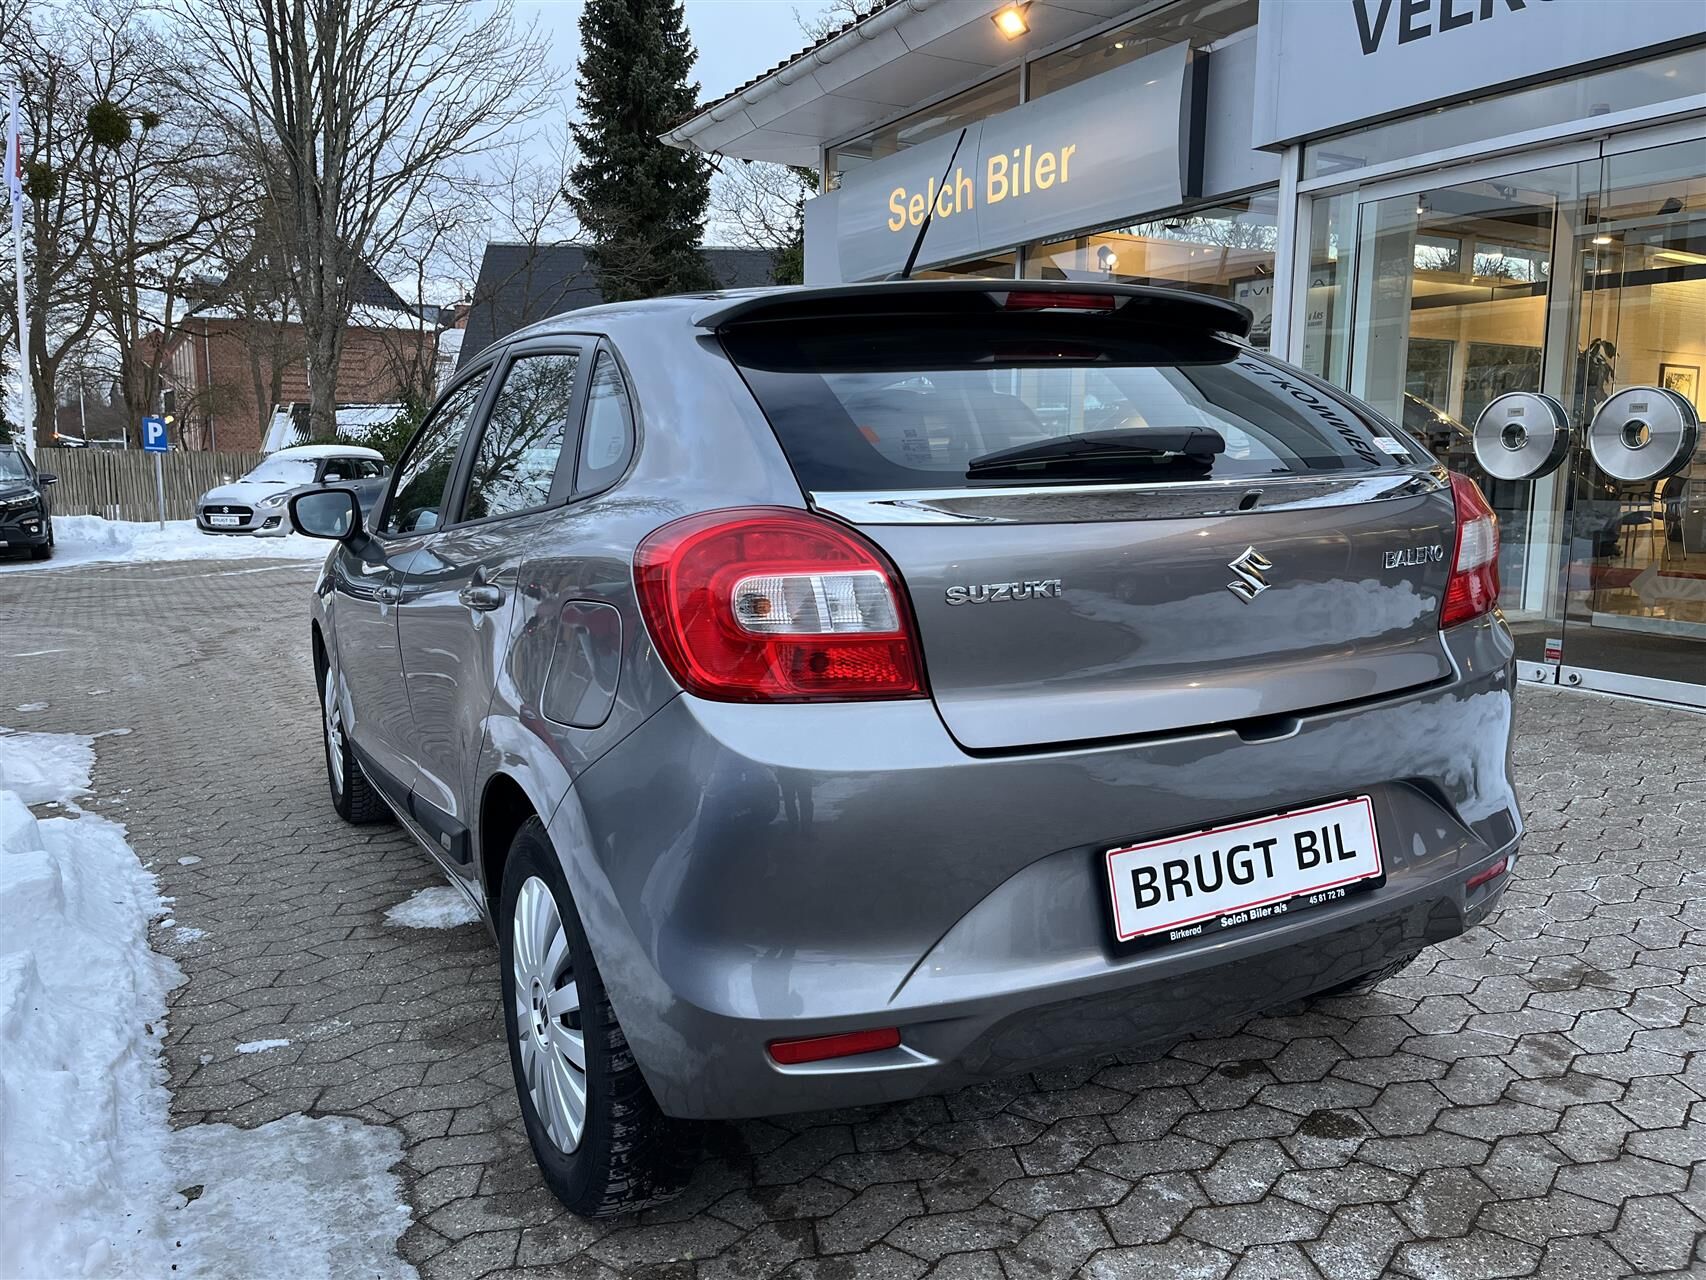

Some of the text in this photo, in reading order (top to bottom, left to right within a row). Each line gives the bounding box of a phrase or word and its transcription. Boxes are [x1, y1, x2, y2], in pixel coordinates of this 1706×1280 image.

[888, 144, 1076, 232] Selch Biler
[147, 421, 163, 444] P
[1382, 545, 1444, 569] BALENO
[945, 579, 1062, 606] SUZUKI
[1131, 823, 1357, 909] BRUGT BIL
[1220, 912, 1248, 927] Selch
[1249, 907, 1272, 920] Biler
[1273, 902, 1288, 914] a/s
[1309, 895, 1318, 904] 45
[1318, 893, 1327, 902] 81
[1327, 890, 1336, 900] 72
[1336, 888, 1346, 897] 78
